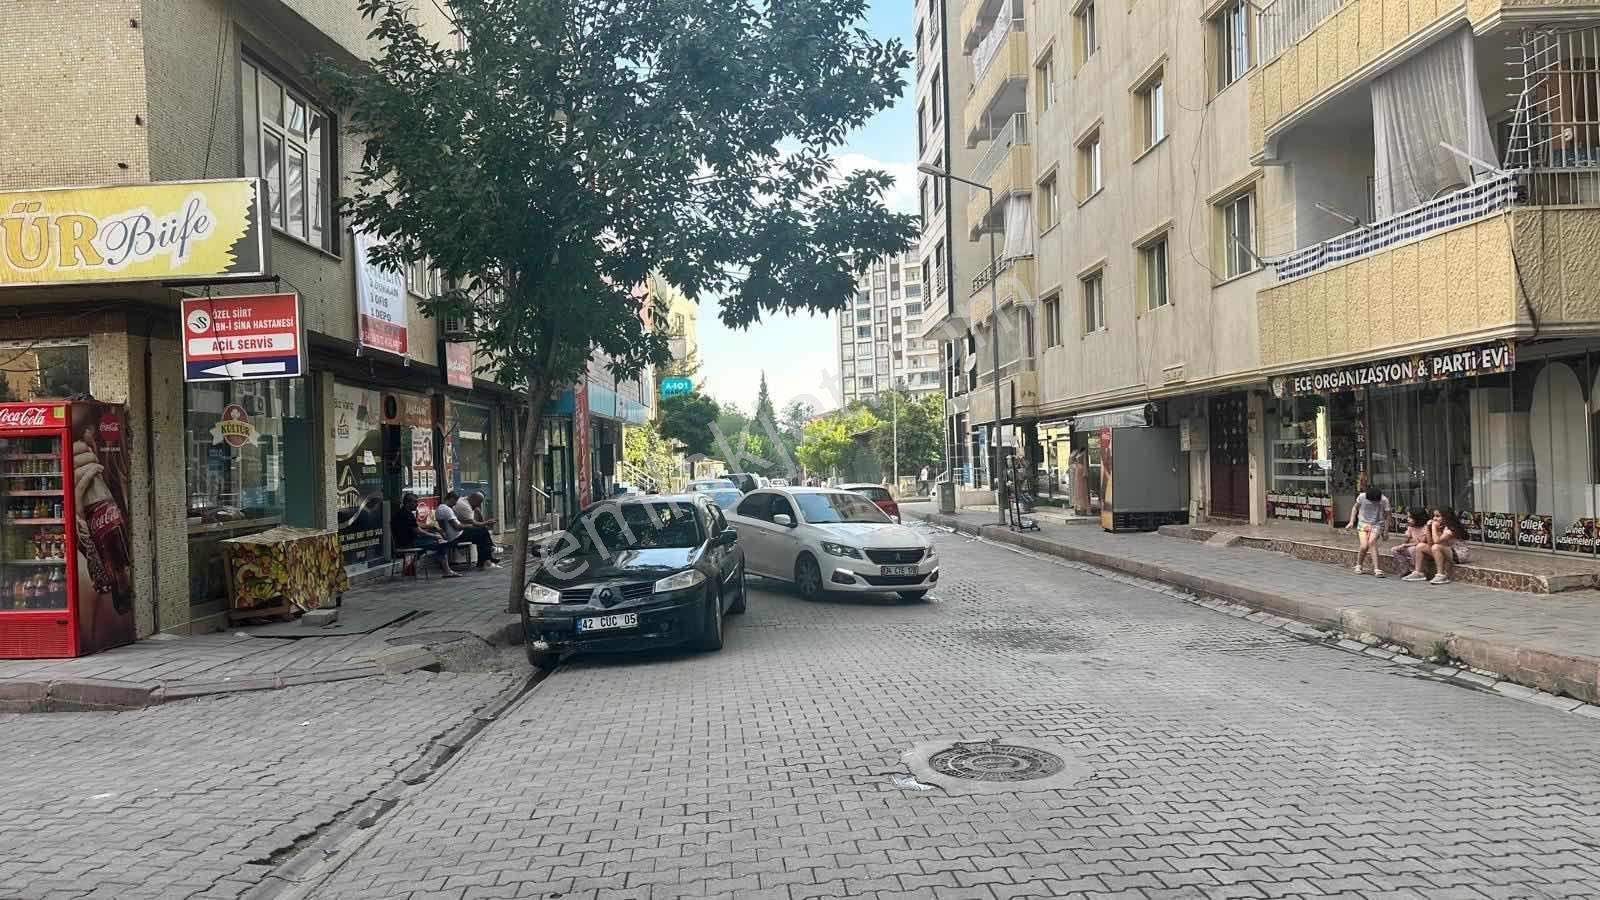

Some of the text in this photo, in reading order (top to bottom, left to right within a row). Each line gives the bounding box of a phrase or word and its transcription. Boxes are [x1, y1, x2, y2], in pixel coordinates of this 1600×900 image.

[0, 198, 210, 269] ÜR Büfe
[212, 308, 230, 320] ÖZEL
[375, 309, 391, 321] DEPO
[233, 318, 251, 331] SİNA
[253, 316, 294, 329] HASTANESİ
[238, 336, 273, 350] SERVİS
[1294, 377, 1312, 392] ECE
[1417, 361, 1429, 377] &
[0, 407, 48, 427] Coca-Cola
[221, 421, 250, 434] KÜLTÜR
[1484, 517, 1513, 529] helyum
[1520, 519, 1544, 531] dilek
[1487, 529, 1511, 540] balon
[582, 614, 636, 629] 42 CUC 05
